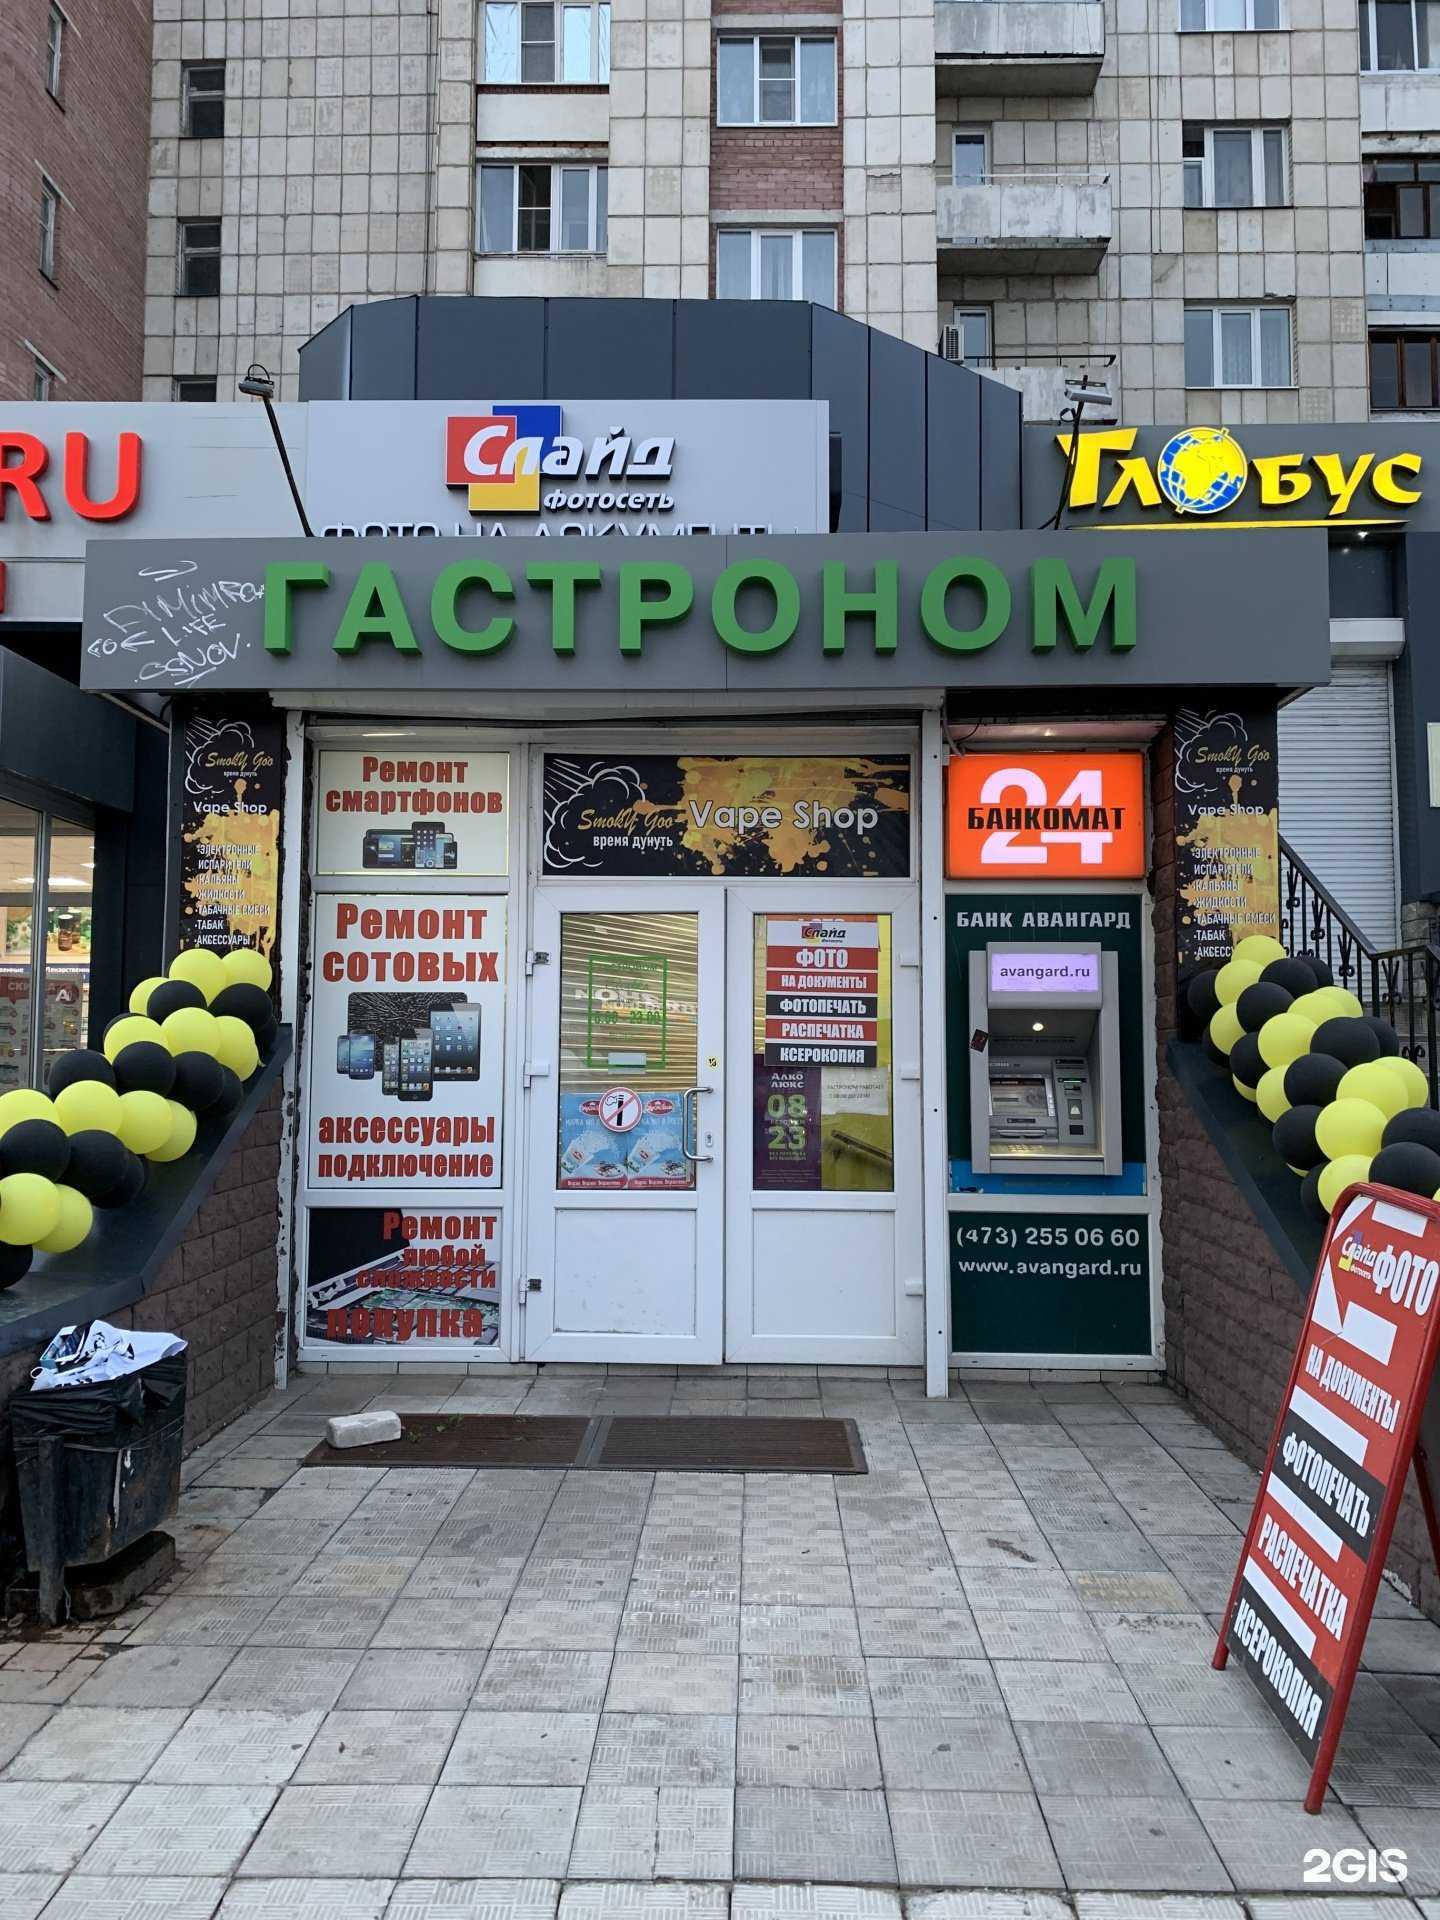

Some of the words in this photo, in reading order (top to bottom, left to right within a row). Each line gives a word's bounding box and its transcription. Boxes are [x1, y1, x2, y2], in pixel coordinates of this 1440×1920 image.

[463, 425, 676, 480] Слайд
[264, 556, 1138, 656] ГАСТРОНОМ
[363, 757, 468, 783] Ремонт
[193, 802, 229, 814] Vape
[234, 802, 267, 814] Shop
[326, 788, 503, 815] смартфонов
[1188, 804, 1225, 817] Vape
[1230, 804, 1264, 817] Shop
[689, 800, 783, 835] Vape
[793, 800, 879, 835] Shop
[968, 808, 1125, 829] БАНКОМАТ
[980, 768, 1113, 864] 24
[593, 836, 628, 850] время
[632, 836, 673, 850] дунуть
[1195, 848, 1261, 859] ЭЛЕКТРОННЫЕ
[197, 920, 224, 930] ТАБАК
[337, 903, 488, 940] Ремонт
[957, 912, 1013, 928] БАНК
[1022, 912, 1131, 929] АВАНГАРД
[197, 935, 250, 945] АКСЕССУАРЫ
[805, 927, 846, 938] Слайд
[1196, 930, 1225, 940] ТАБАК
[323, 951, 499, 983] сотовых
[795, 948, 848, 968] ФОТО
[781, 975, 796, 987] НА
[797, 975, 867, 989] ДОКУМЕНТЫ
[1000, 966, 1090, 980] avangard.ru
[780, 999, 867, 1015] ФОТОПЕЧАТЬ
[781, 1023, 864, 1039] РАСПЕЧАТКА
[780, 1048, 865, 1064] КСЕРОКОПИЯ
[767, 1094, 806, 1118] 08
[319, 1117, 495, 1146] аксессуары
[767, 1125, 806, 1150] 23
[318, 1154, 493, 1181] подключение
[384, 1212, 497, 1240] Ремонт
[956, 1226, 1017, 1248] (473)
[1025, 1227, 1068, 1246] 255
[1075, 1228, 1104, 1247] 06
[1111, 1229, 1140, 1247] 60
[403, 1244, 486, 1266] любой
[1341, 1236, 1378, 1267] Слайд
[356, 1270, 496, 1288] сложности
[959, 1259, 1142, 1278] www.avangard.ru
[1372, 1244, 1440, 1316] ФОТО
[327, 1308, 483, 1341] покупка
[1305, 1343, 1321, 1380] НА
[1318, 1355, 1401, 1433] ДОКУМЕНТЫ
[1282, 1431, 1371, 1538] ФОТОПЕЧАТЬ
[1257, 1513, 1348, 1641] РАСПЕЧАТКА
[1233, 1598, 1323, 1740] КСЕРОКОПИЯ
